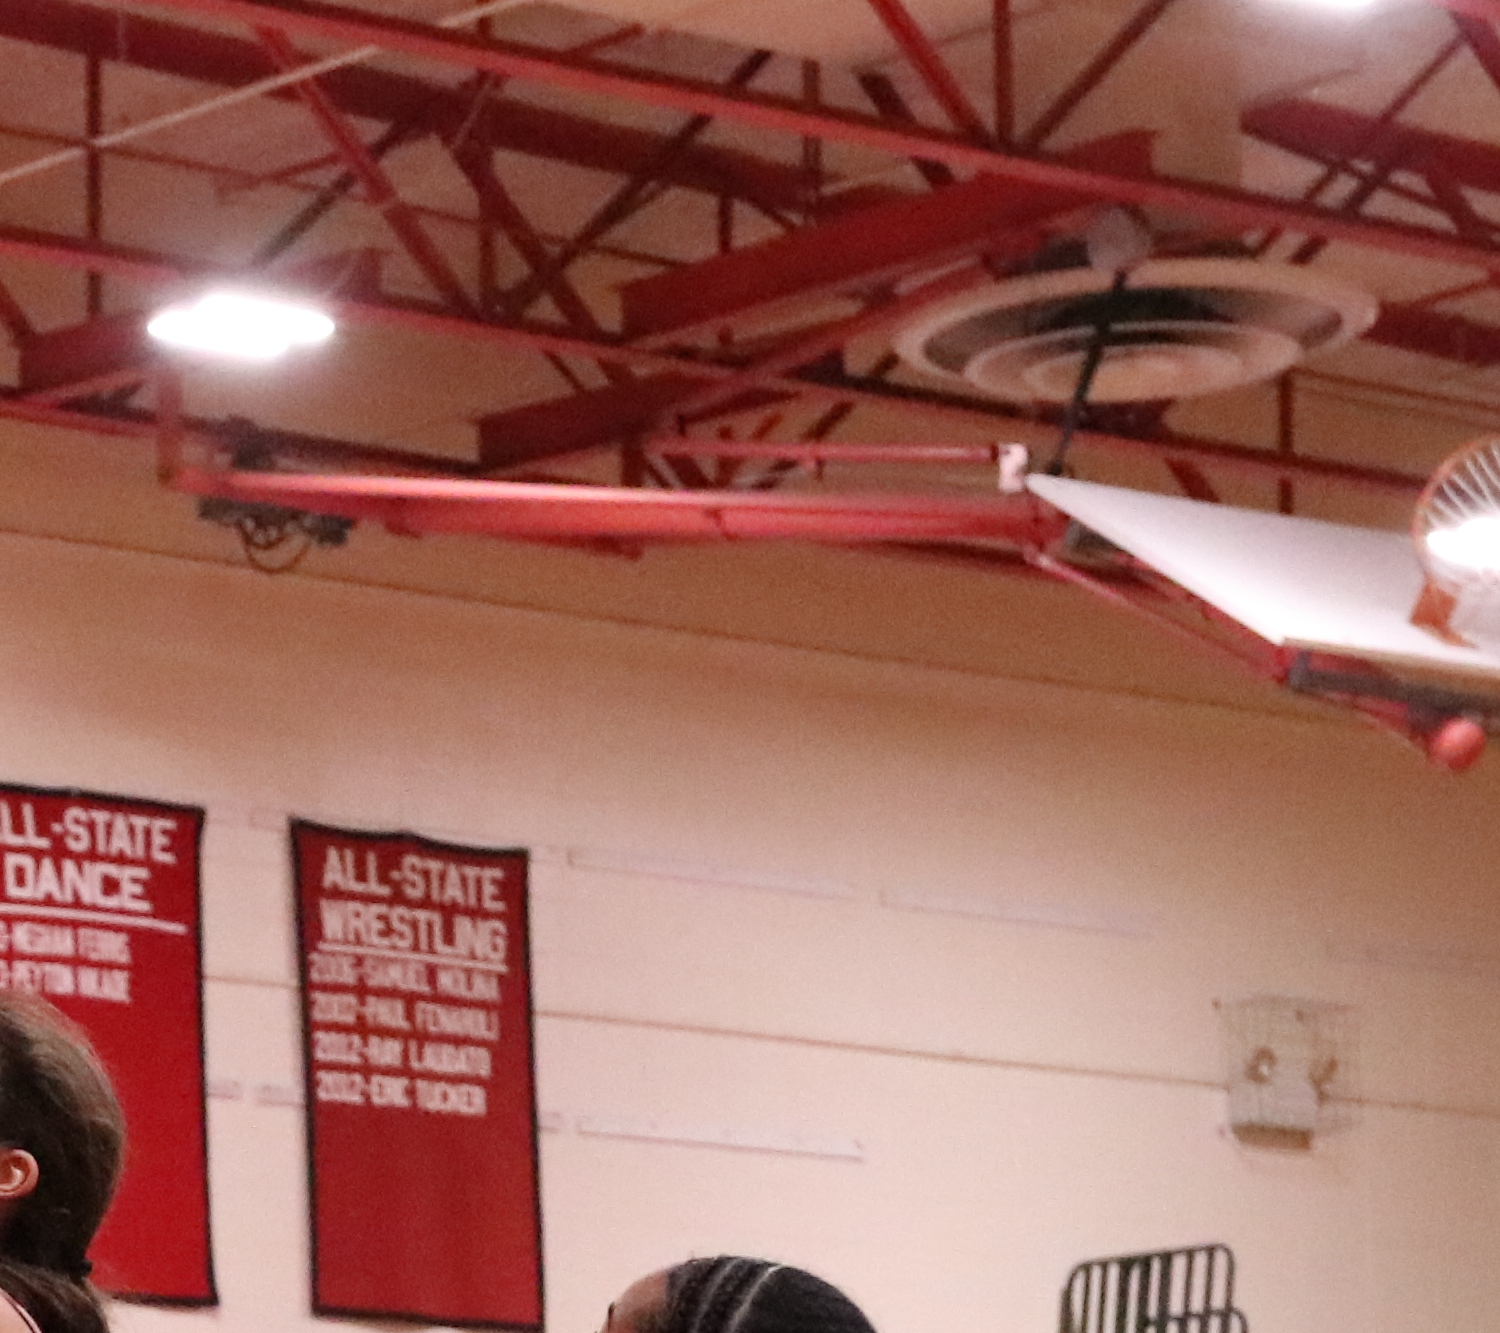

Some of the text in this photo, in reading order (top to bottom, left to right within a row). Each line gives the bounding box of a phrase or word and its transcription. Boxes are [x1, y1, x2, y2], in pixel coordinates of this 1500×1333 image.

[4, 852, 152, 913] DANCE
[321, 845, 506, 912] ALL-STATE
[319, 898, 507, 962] WRESTLING
